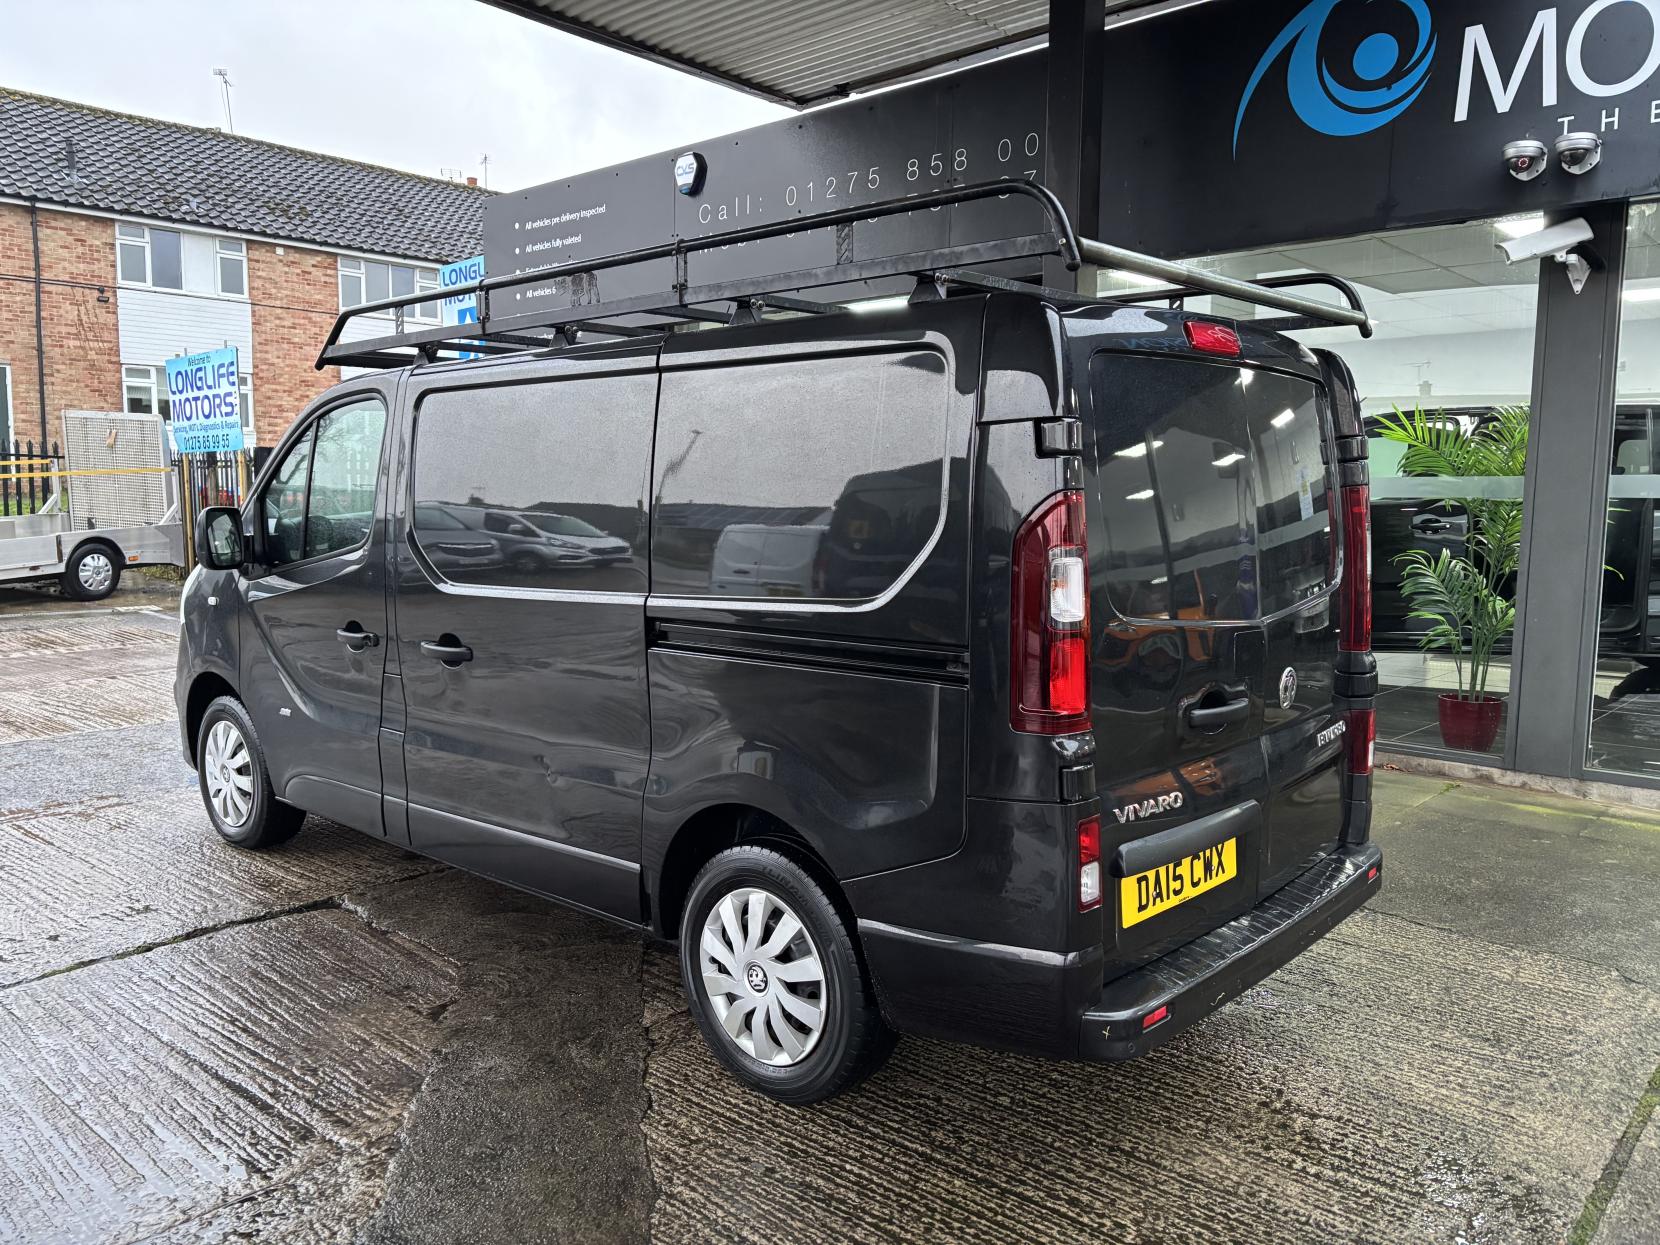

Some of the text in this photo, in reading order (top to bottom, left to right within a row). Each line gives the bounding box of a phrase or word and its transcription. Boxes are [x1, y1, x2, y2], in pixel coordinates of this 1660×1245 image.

[699, 194, 762, 223] Call:
[785, 167, 880, 206] 01275
[906, 148, 968, 181] 858
[532, 218, 552, 229] vehicles
[560, 211, 580, 223] delivery
[532, 241, 552, 251] vehicles
[552, 238, 562, 248] fully
[562, 233, 582, 245] valeted
[533, 287, 552, 297] vehicles
[168, 361, 236, 395] LONGLIFE
[172, 392, 235, 422] MOTORS
[184, 433, 230, 451] 01275 85 99 55
[1112, 791, 1184, 824] VIVARO
[1136, 843, 1226, 914] DA15 CWX
